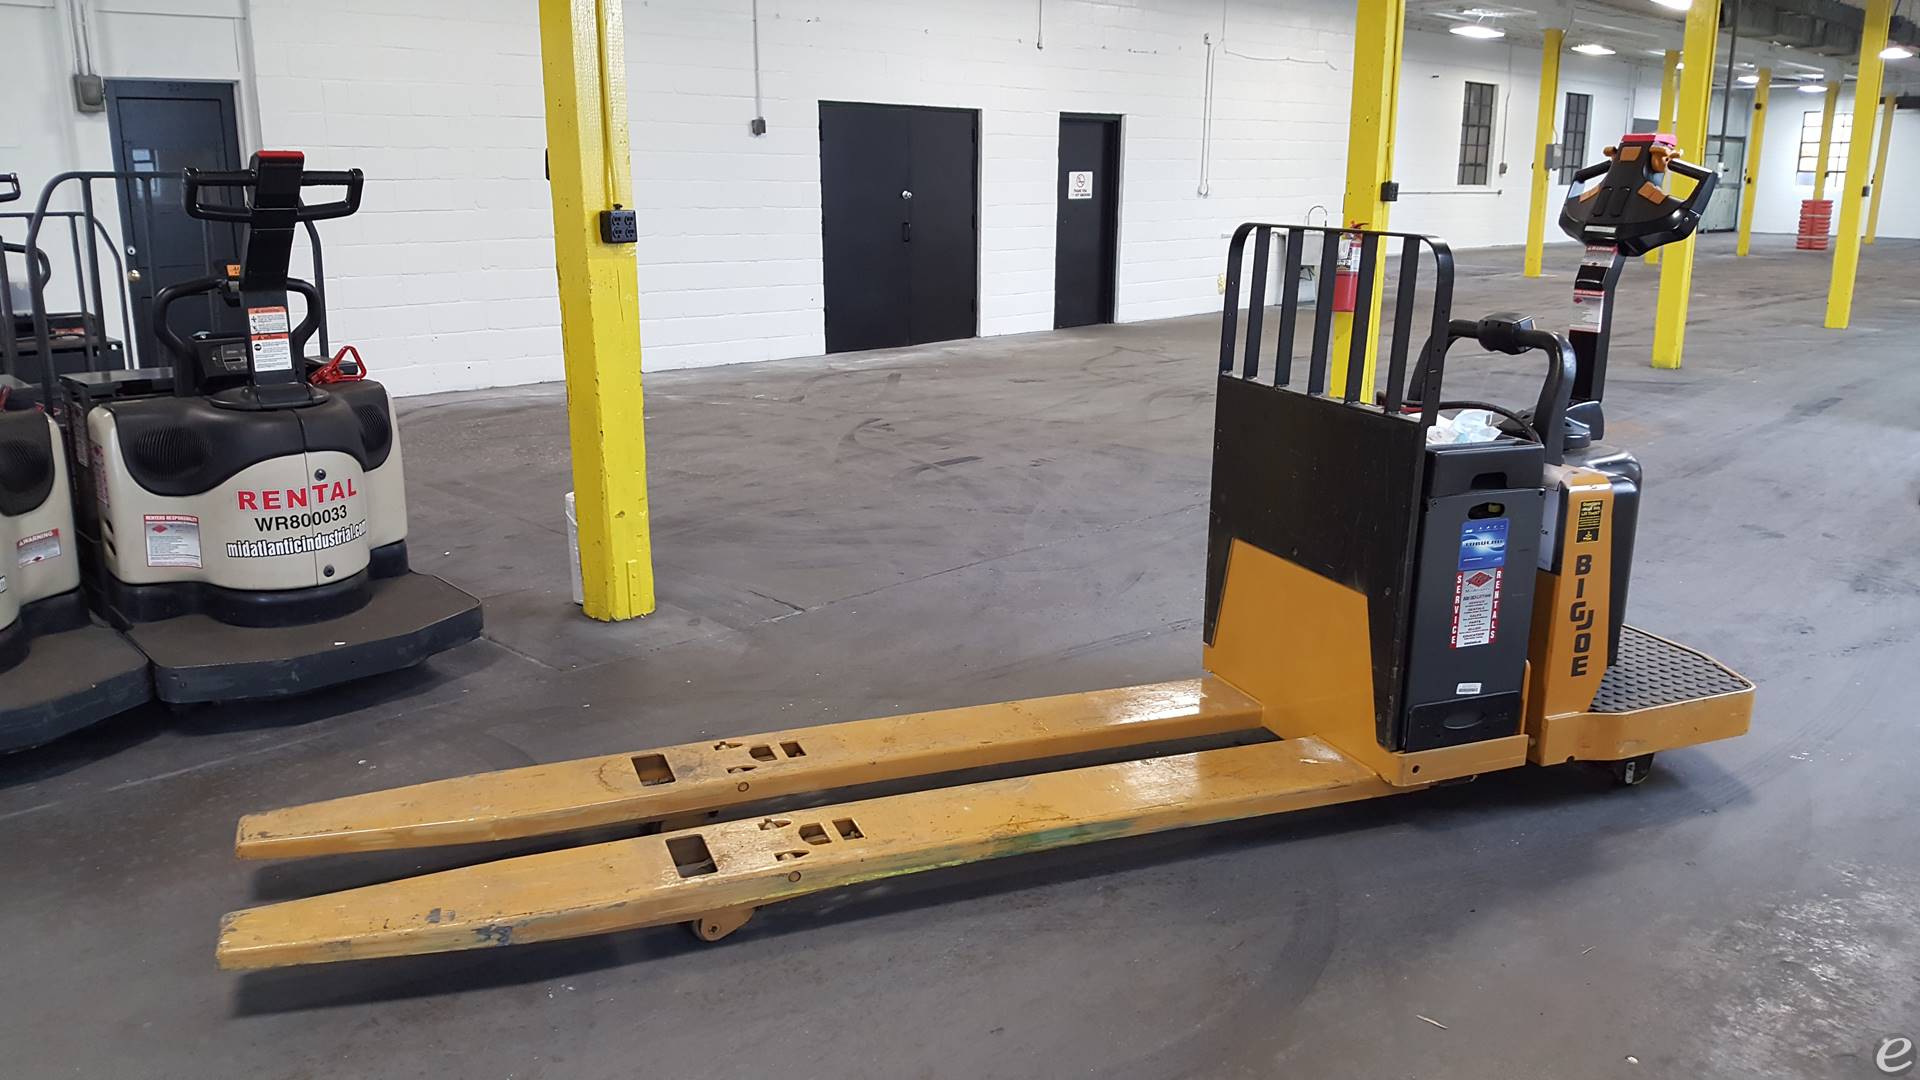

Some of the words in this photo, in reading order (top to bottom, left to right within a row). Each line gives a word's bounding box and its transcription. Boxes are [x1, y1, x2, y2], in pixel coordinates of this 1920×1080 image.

[237, 478, 357, 511] RENTAL
[255, 504, 347, 532] WR800033
[22, 531, 54, 545] WARNING
[226, 518, 368, 559] midatlanticindustrial.com
[1451, 575, 1462, 644] SERVICE
[1490, 570, 1502, 639] RENTALS
